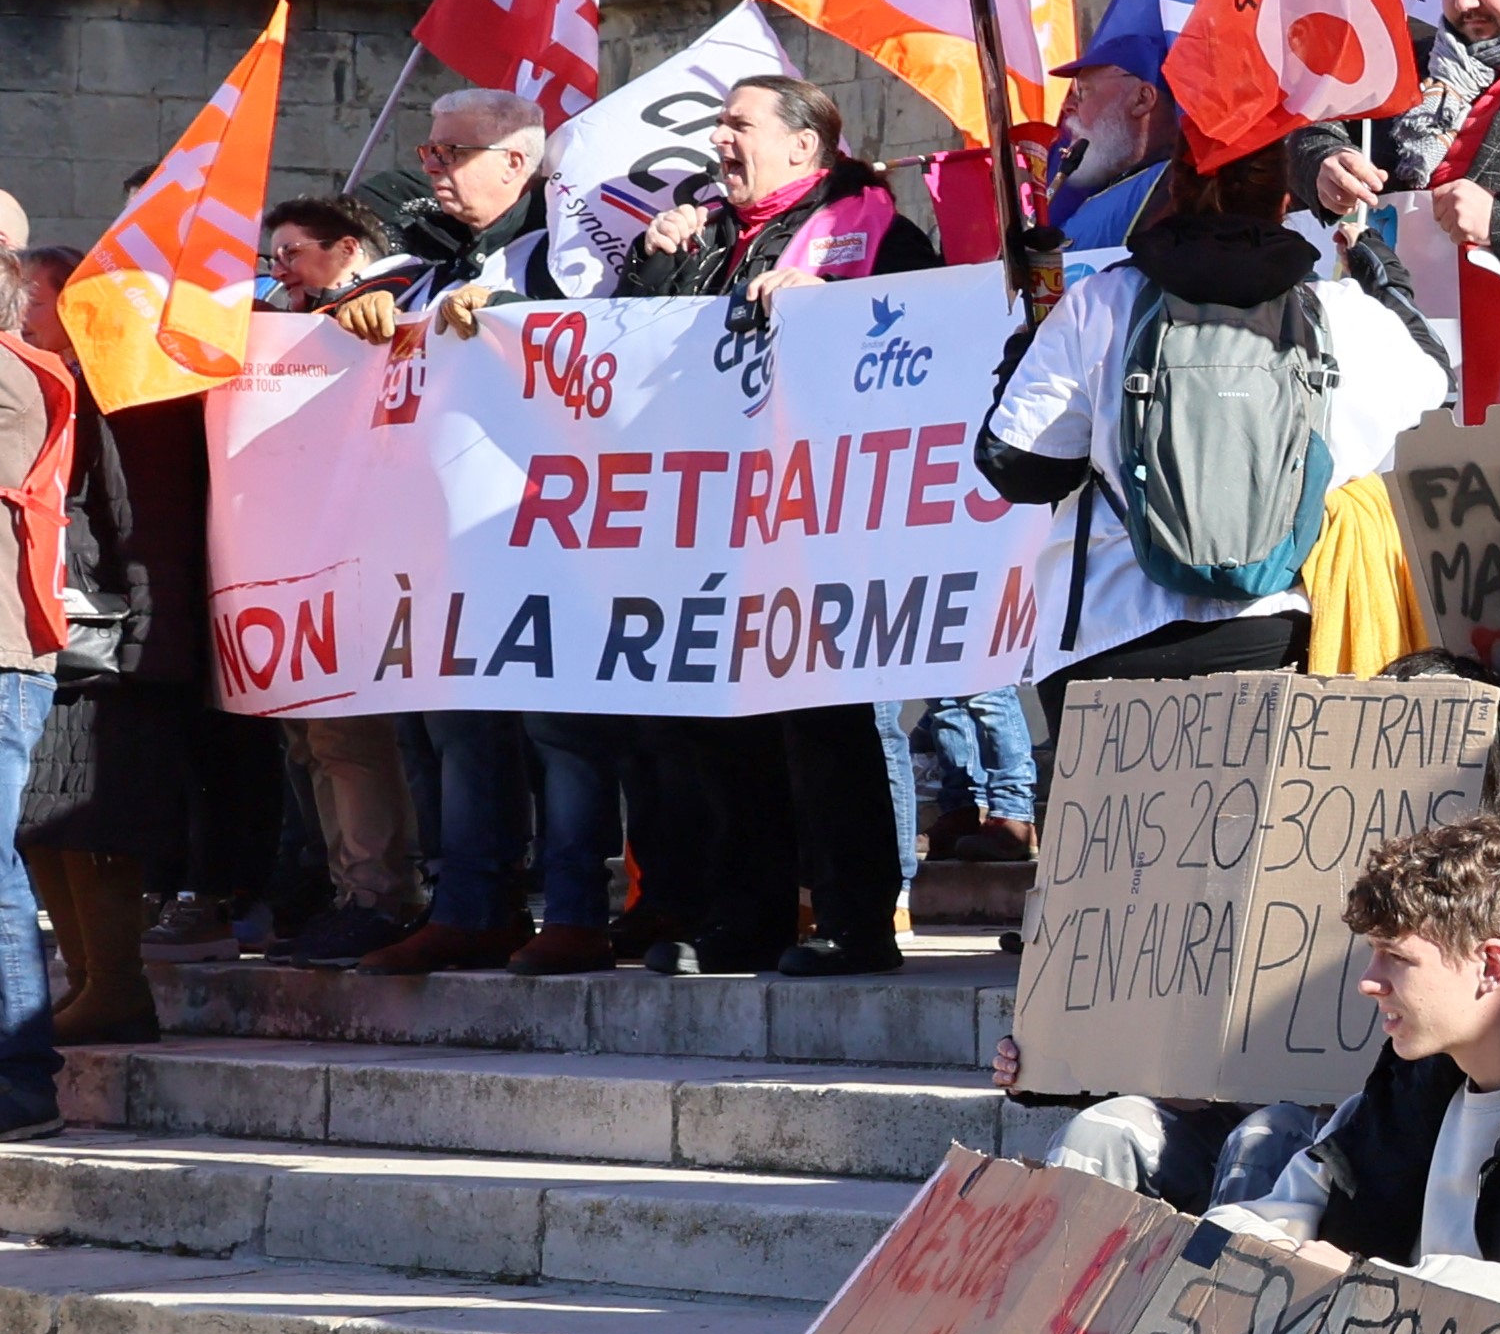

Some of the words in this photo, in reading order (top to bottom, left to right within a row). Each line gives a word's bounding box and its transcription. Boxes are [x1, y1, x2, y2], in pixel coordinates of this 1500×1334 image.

[256, 363, 286, 378] POUR
[287, 363, 328, 379] CHACUN
[256, 378, 282, 393] TOUS
[853, 336, 933, 394] cftc
[508, 421, 1015, 552] RETRAITES
[211, 589, 340, 703] NON
[373, 572, 414, 684] À
[439, 591, 556, 681] LA
[598, 572, 977, 686] RÉFORME
[1058, 691, 1223, 779] J'ADORE
[1222, 692, 1272, 768] LA
[1280, 691, 1495, 772] RETRAITE
[1476, 689, 1491, 721] HAUT
[1052, 789, 1168, 886] DANS
[1176, 777, 1355, 873] 20-30
[1020, 905, 1126, 1015] Y'EN
[1127, 900, 1235, 1000] AURA
